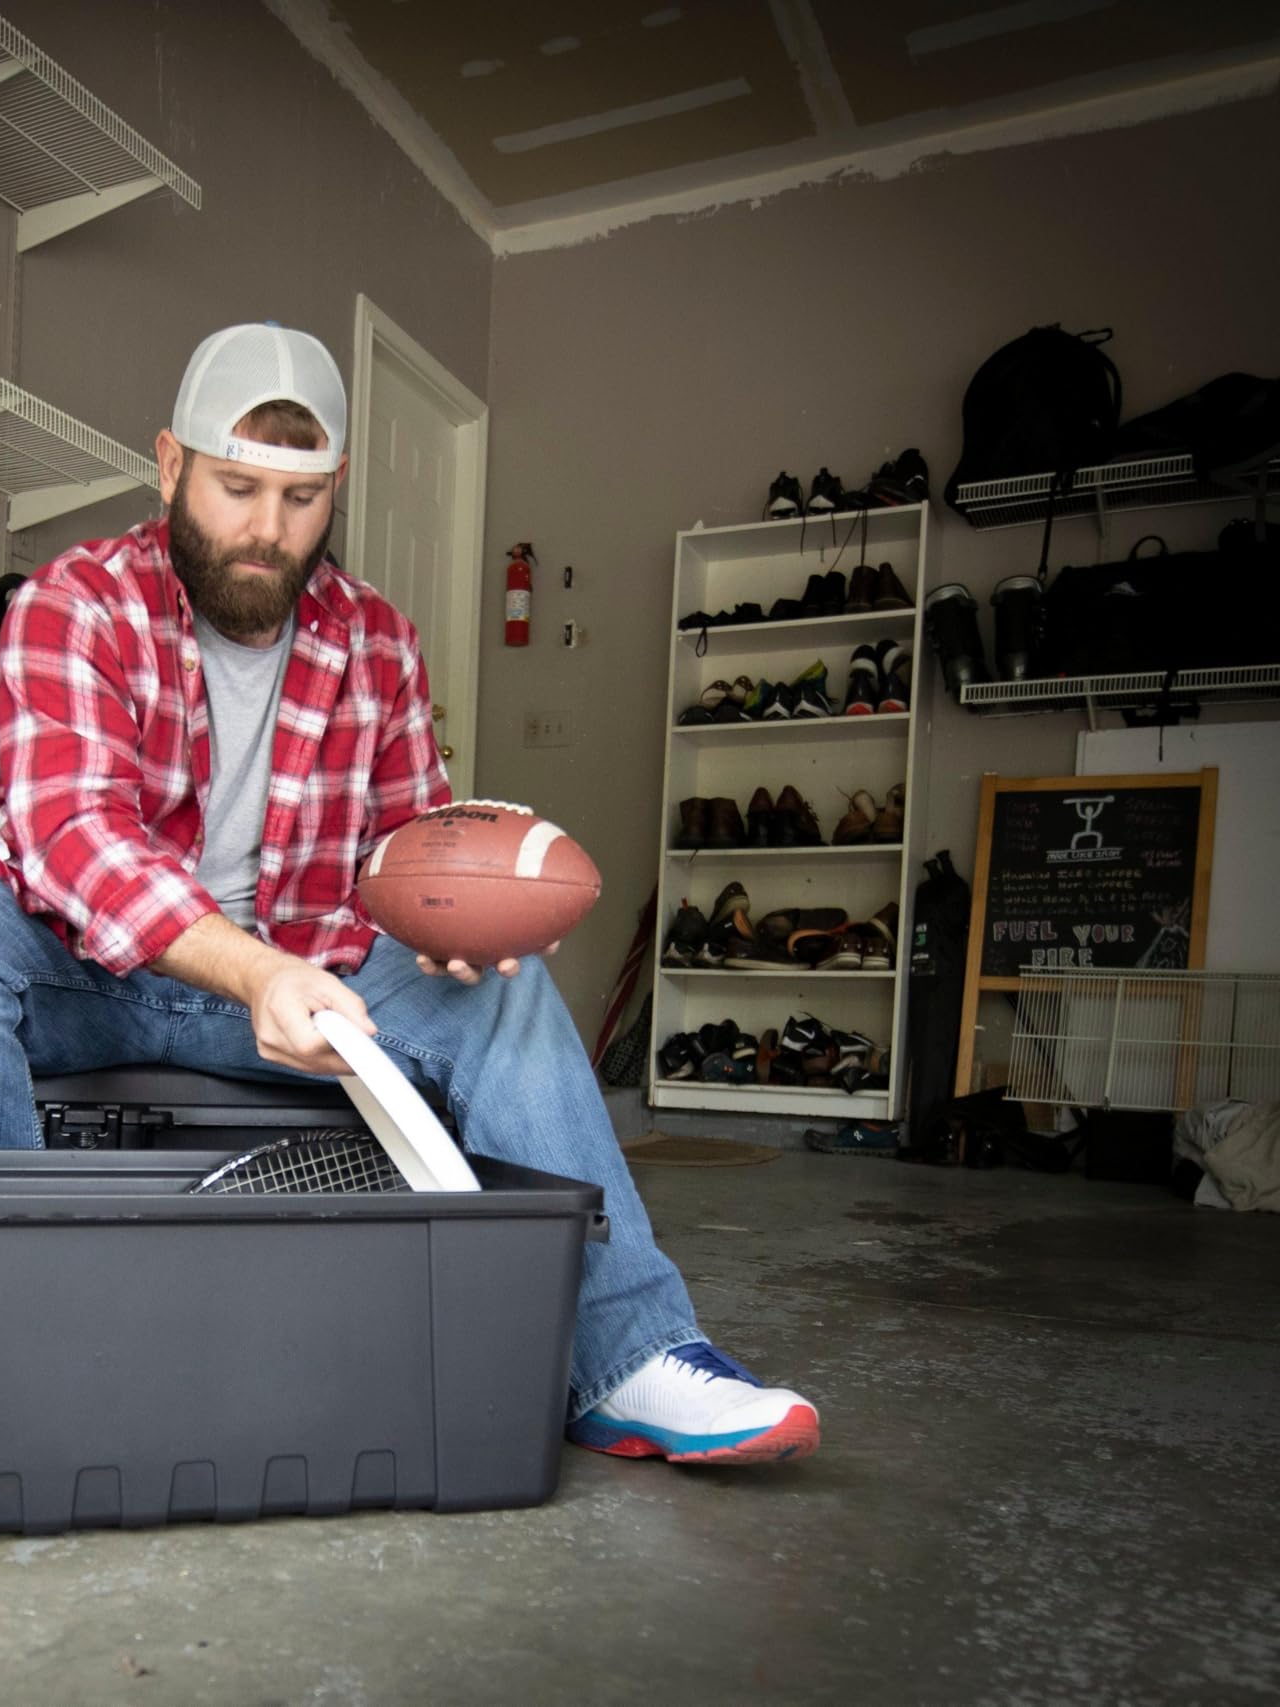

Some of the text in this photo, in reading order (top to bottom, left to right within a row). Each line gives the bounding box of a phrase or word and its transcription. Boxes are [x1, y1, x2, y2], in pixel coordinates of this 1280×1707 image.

[992, 920, 1136, 946] FUEL YOUR
[1031, 947, 1094, 970] FIRE
